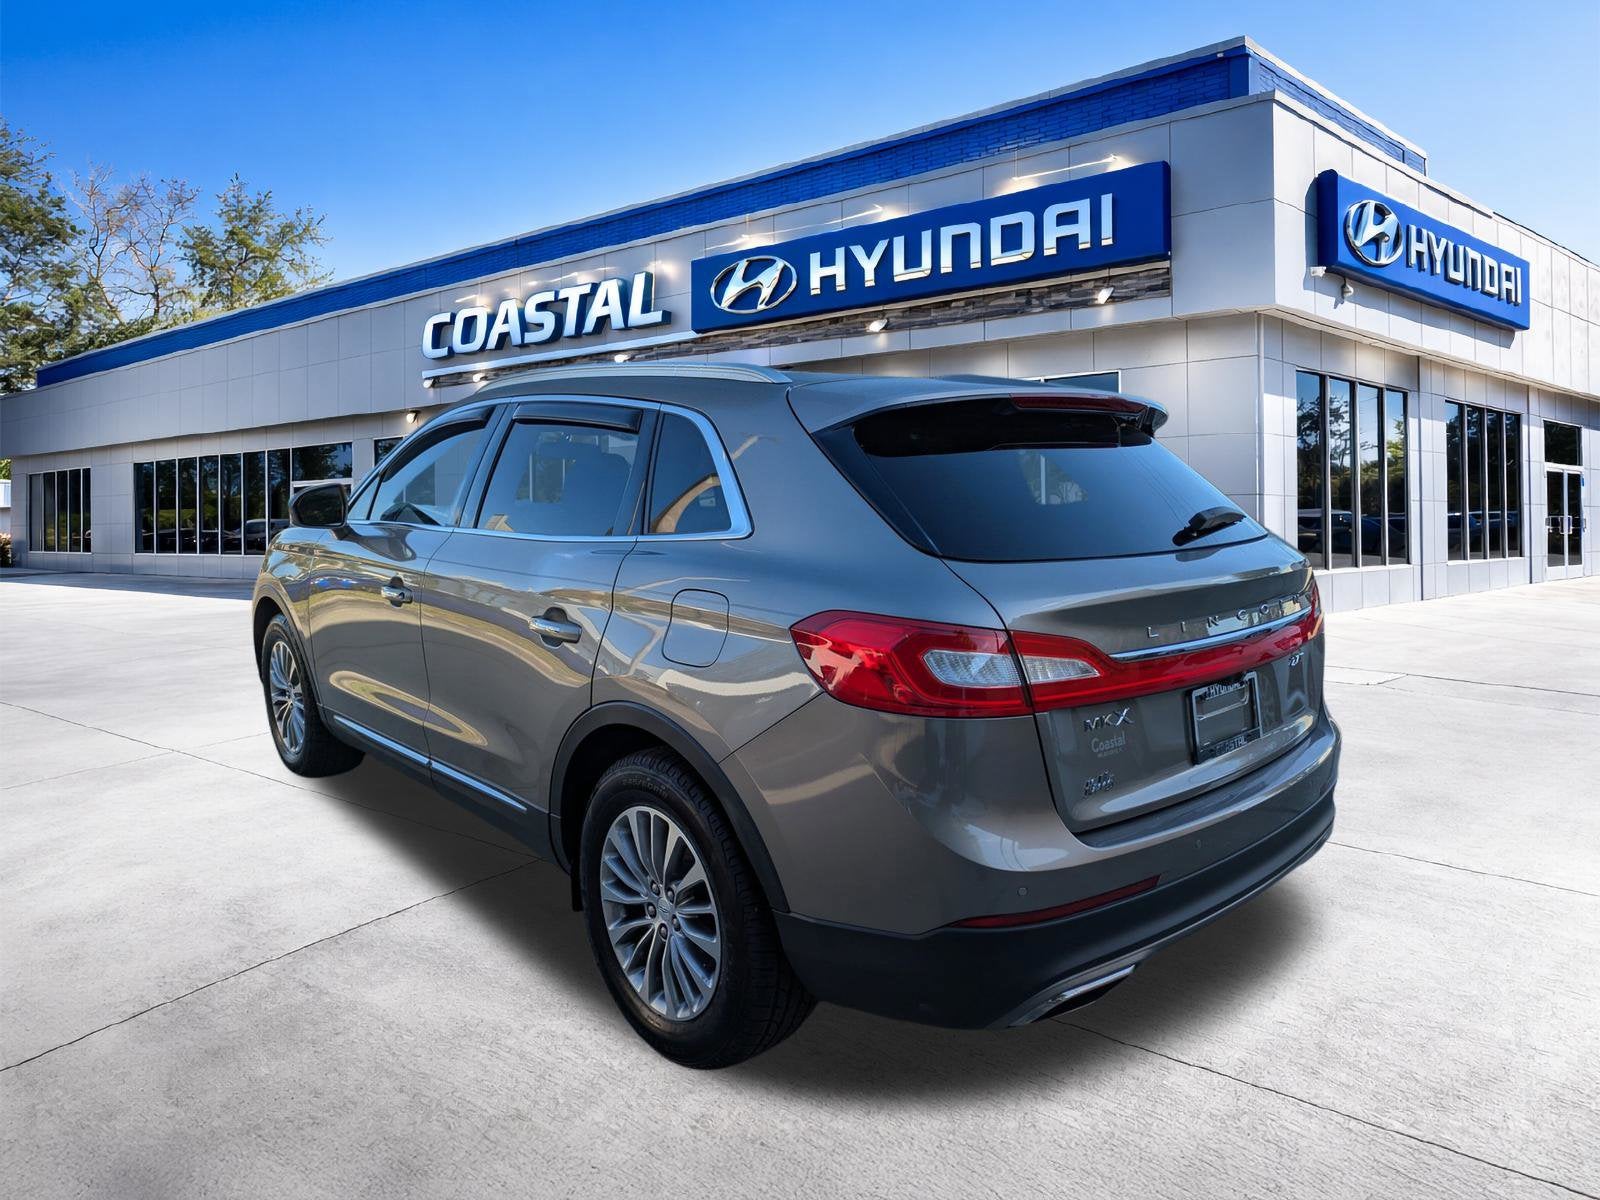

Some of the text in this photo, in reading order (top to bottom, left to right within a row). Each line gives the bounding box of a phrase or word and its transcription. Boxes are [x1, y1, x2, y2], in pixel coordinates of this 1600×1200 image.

[809, 193, 1114, 297] HYUNDAI
[1407, 224, 1522, 306] HYUNDAI
[422, 271, 668, 359] COASTAL
[1091, 730, 1127, 753] Coastal
